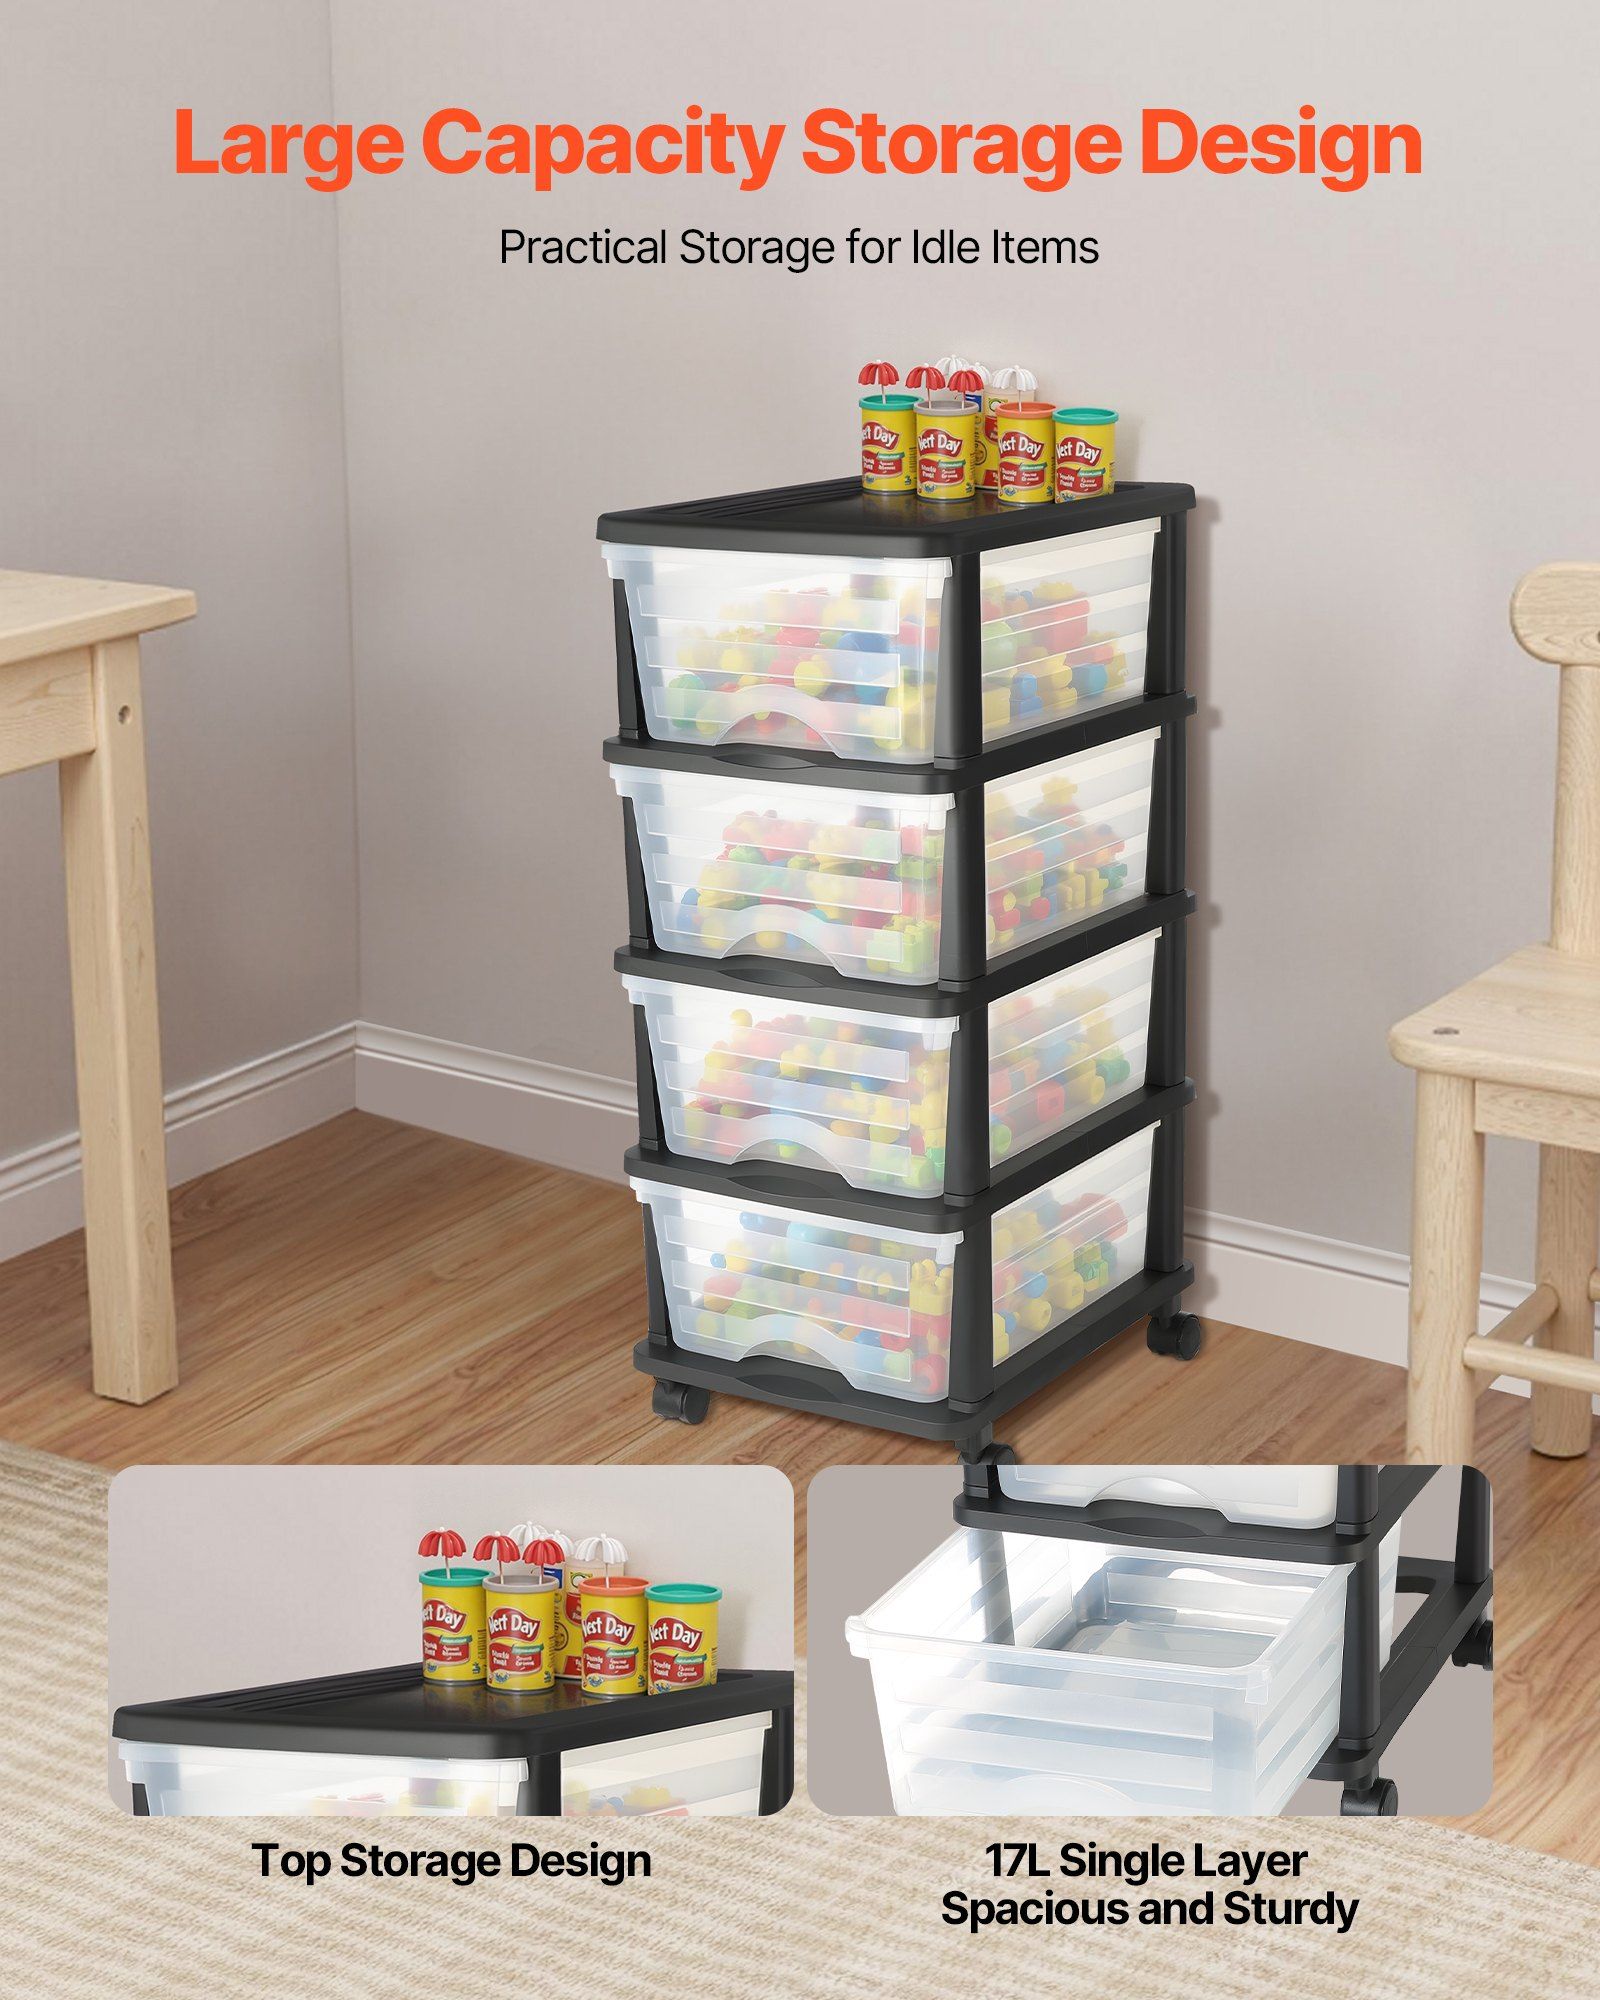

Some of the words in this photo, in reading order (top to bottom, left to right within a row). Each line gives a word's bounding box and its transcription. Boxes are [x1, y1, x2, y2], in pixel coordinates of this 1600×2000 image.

[873, 425, 897, 448] Day
[938, 434, 962, 455] Day
[1018, 436, 1041, 459] Day
[1075, 441, 1100, 464] Day
[436, 1604, 464, 1630] Day
[511, 1614, 539, 1638] Day
[605, 1617, 633, 1643] Day
[671, 1622, 701, 1649] Day
